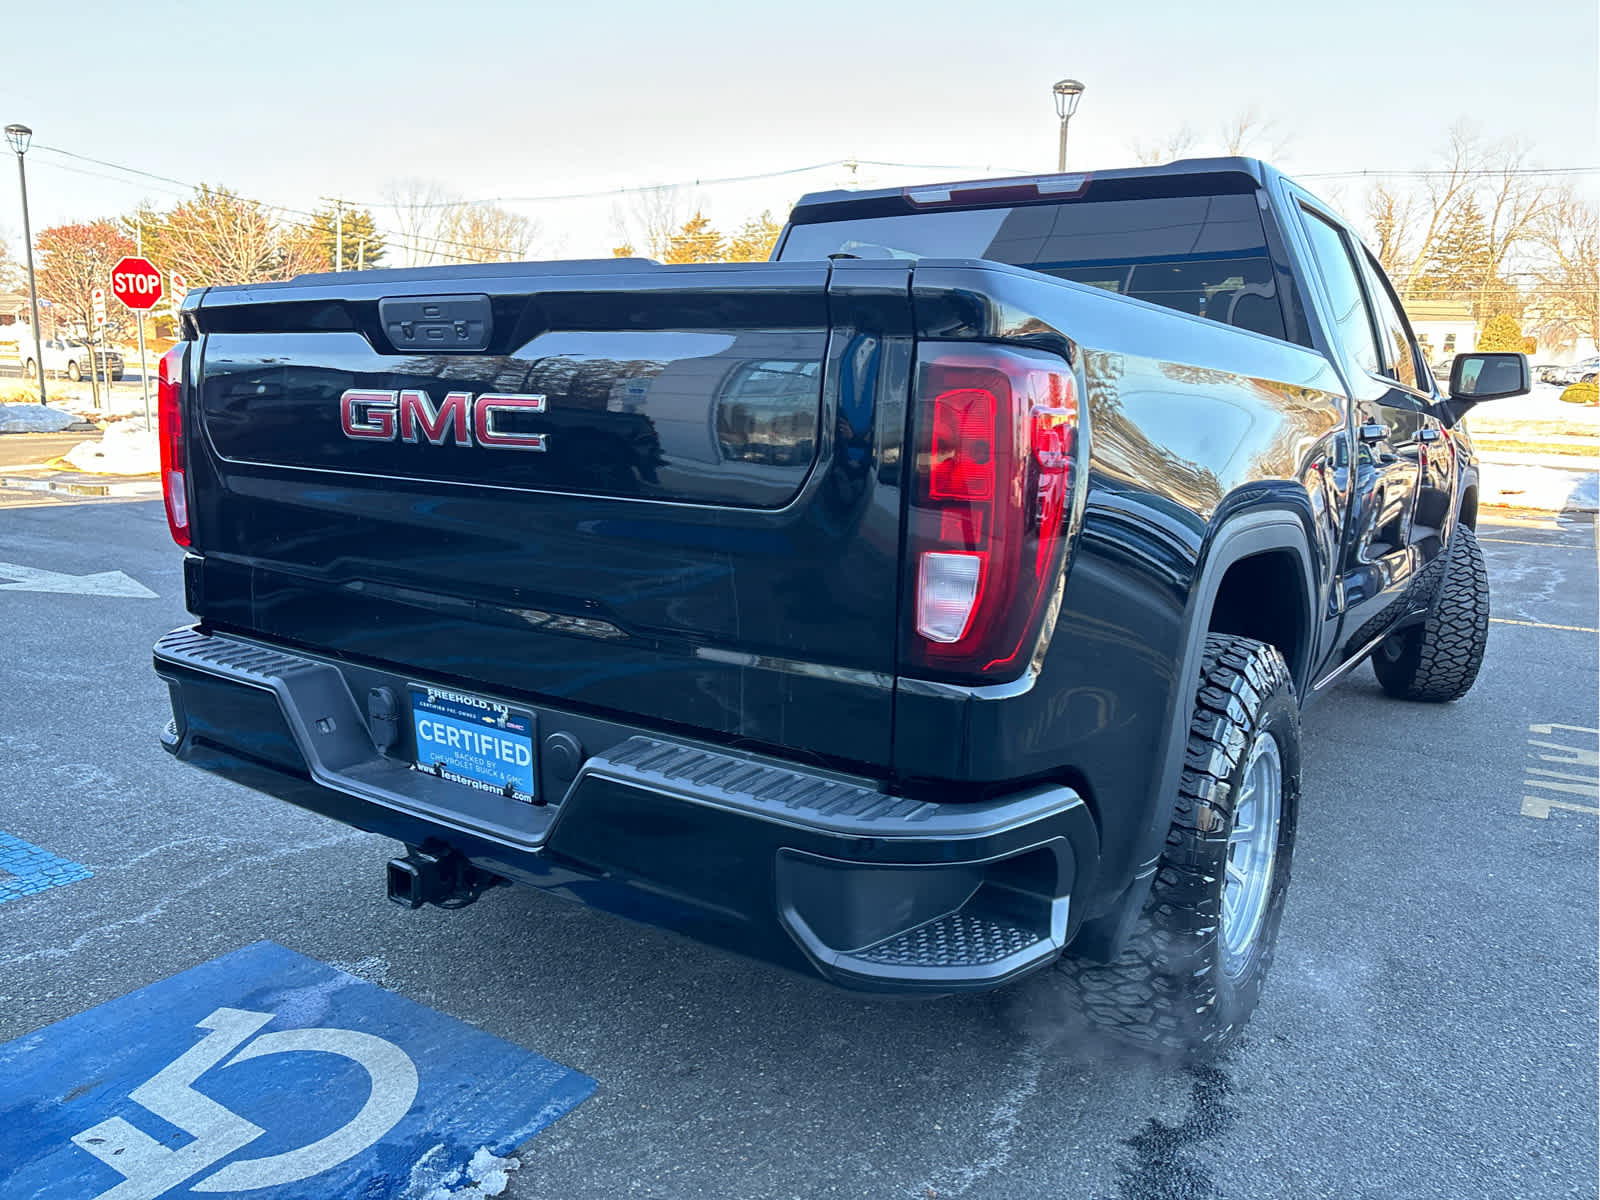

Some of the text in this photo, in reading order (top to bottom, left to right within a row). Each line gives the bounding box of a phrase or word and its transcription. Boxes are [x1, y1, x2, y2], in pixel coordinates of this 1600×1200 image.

[114, 273, 160, 295] STOP
[340, 389, 548, 452] GMC
[427, 688, 509, 714] FREEHOLD, NJ
[418, 719, 531, 767] CERTIFIED
[430, 752, 473, 770] CHEVROLET
[475, 765, 498, 778] BUICK
[506, 774, 524, 785] GMC
[454, 751, 497, 768] BACKED BY
